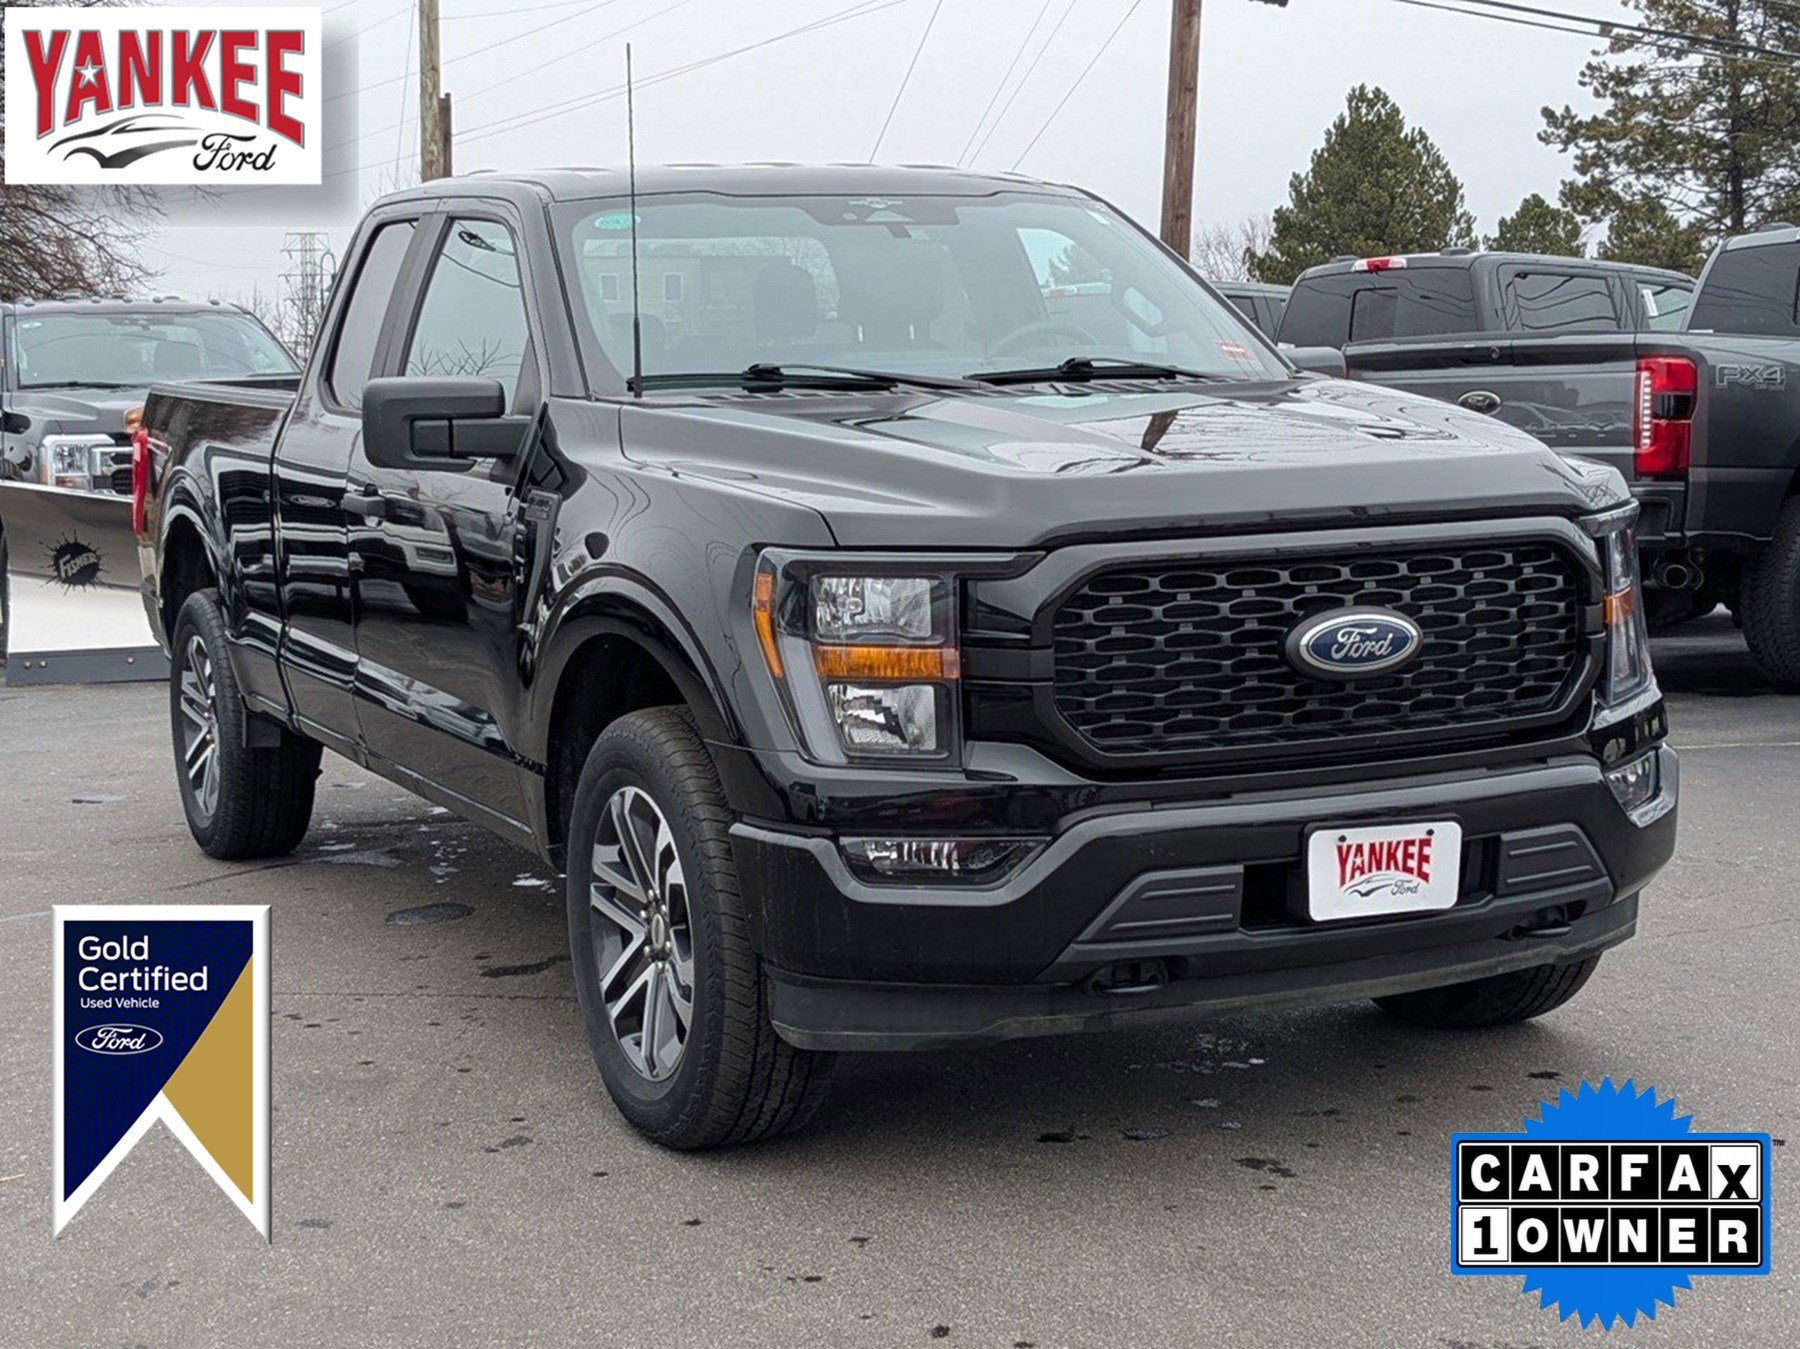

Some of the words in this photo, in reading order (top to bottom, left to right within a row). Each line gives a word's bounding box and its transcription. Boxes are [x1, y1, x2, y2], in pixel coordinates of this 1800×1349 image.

[1716, 364, 1786, 388] FX4
[1331, 627, 1394, 660] Ford
[1336, 835, 1432, 889] YANKEE
[1391, 880, 1421, 896] Ford
